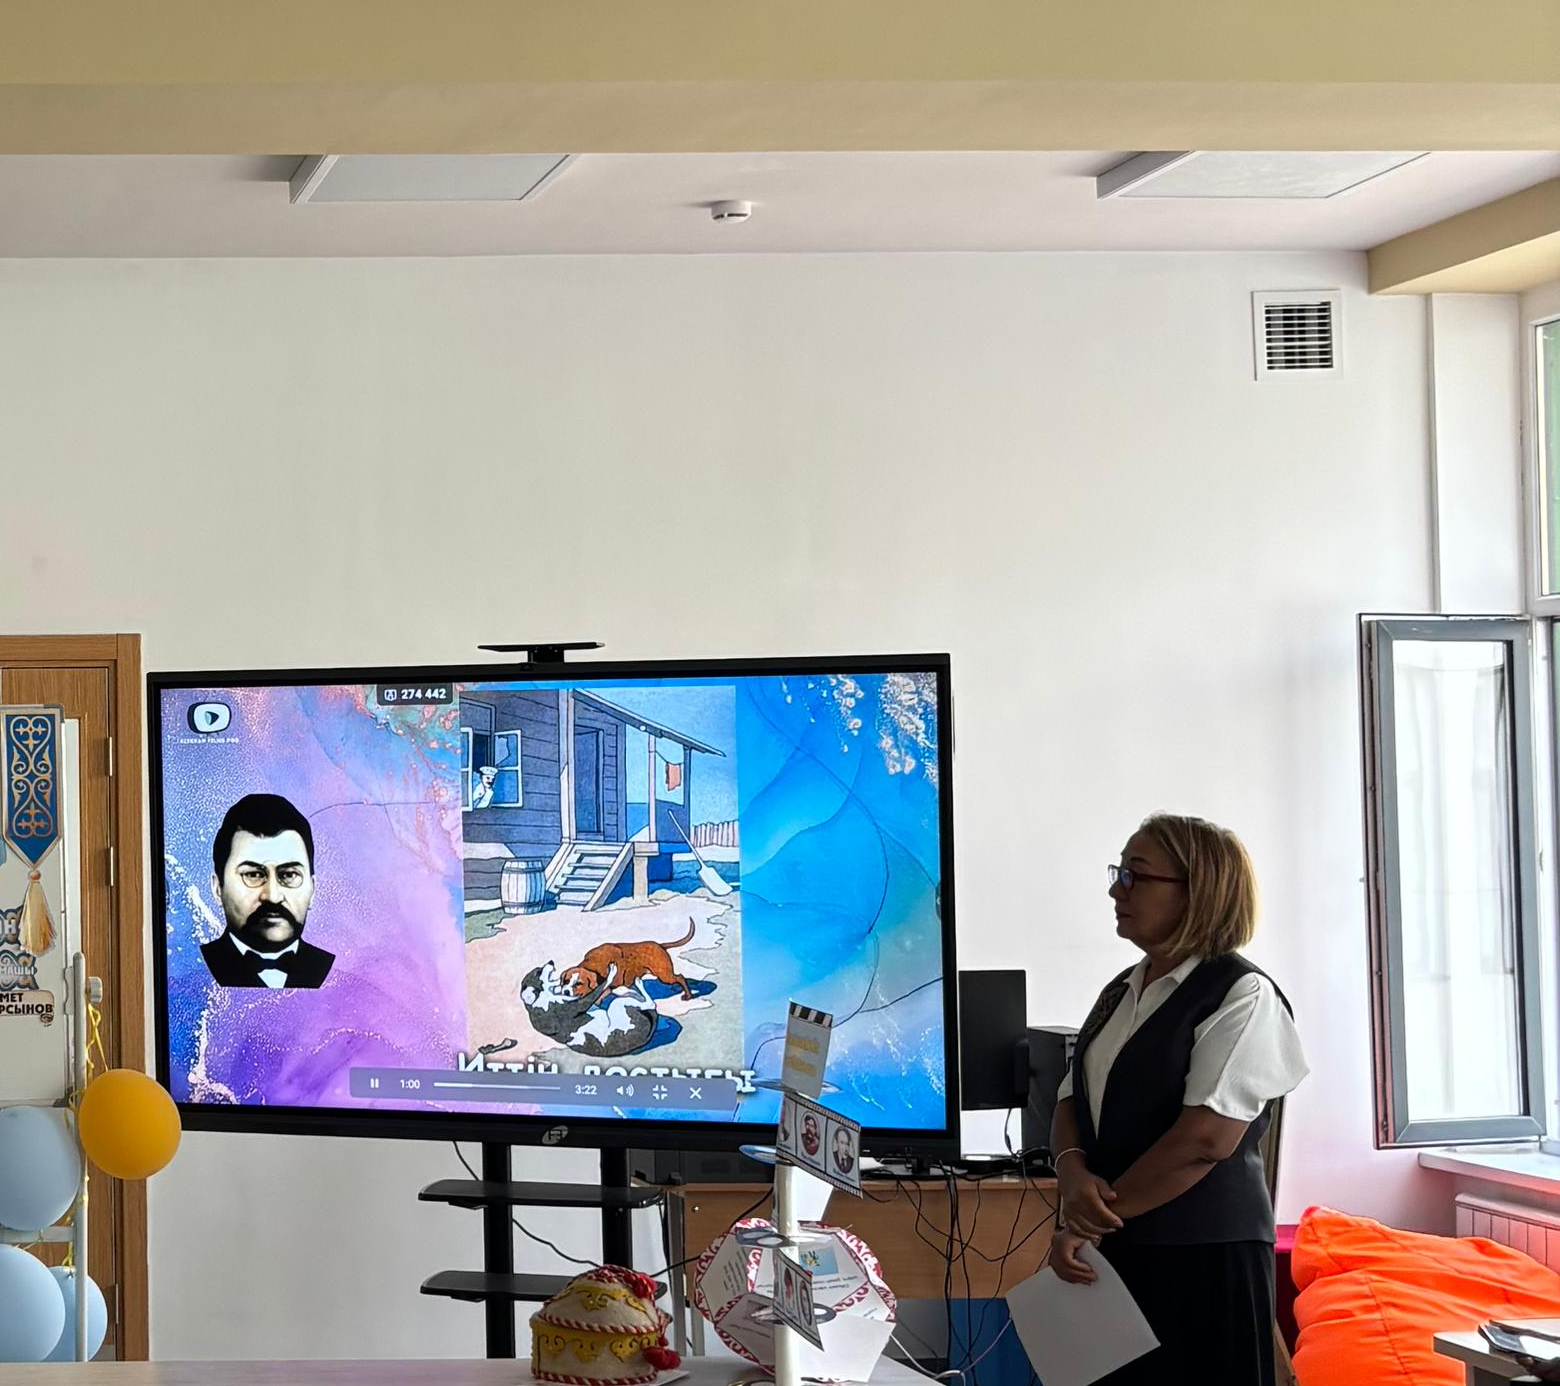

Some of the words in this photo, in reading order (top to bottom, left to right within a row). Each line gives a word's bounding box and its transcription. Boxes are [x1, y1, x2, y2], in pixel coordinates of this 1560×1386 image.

[401, 688, 422, 700] 274
[424, 688, 447, 700] 442
[399, 1078, 421, 1090] 1:00
[574, 1083, 598, 1096] 3:22
